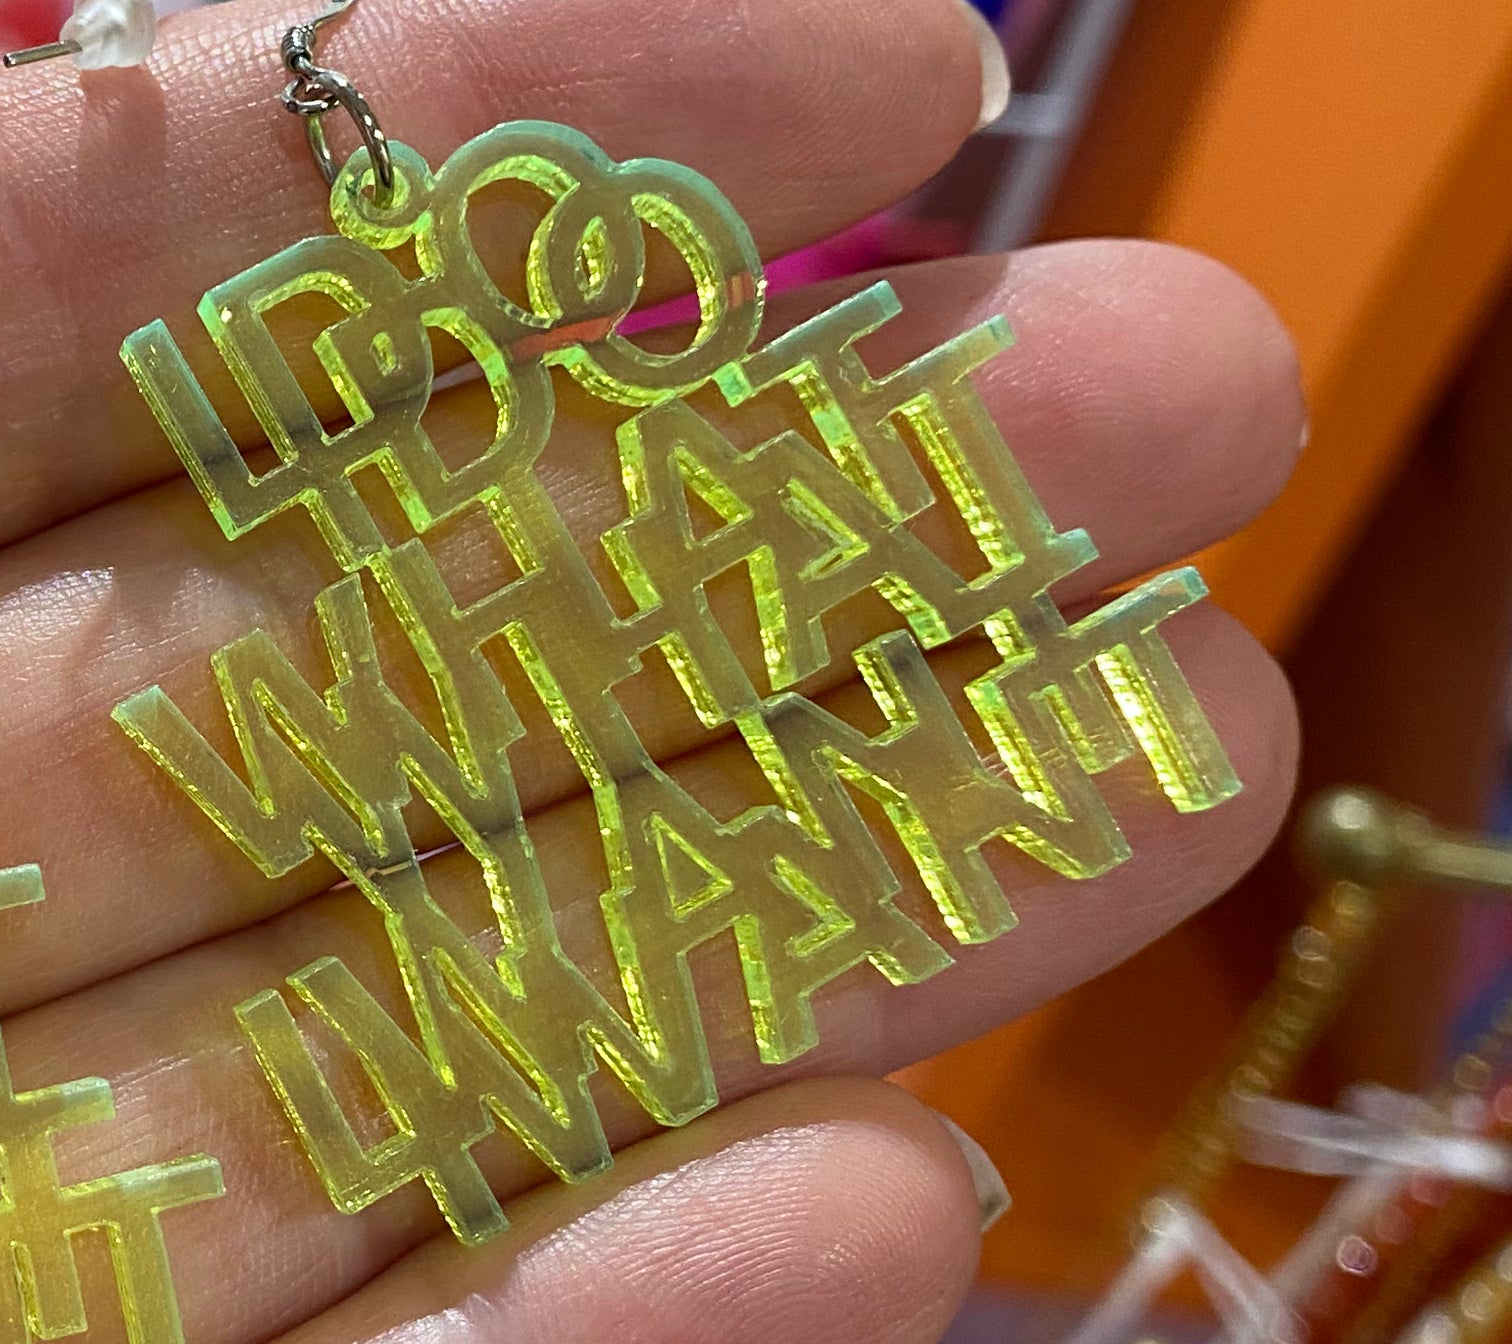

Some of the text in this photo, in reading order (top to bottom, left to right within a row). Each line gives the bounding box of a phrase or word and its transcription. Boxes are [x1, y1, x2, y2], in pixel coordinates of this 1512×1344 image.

[110, 278, 1100, 926] WHAT
[198, 118, 768, 536] DO
[285, 564, 1245, 1186] WANT
